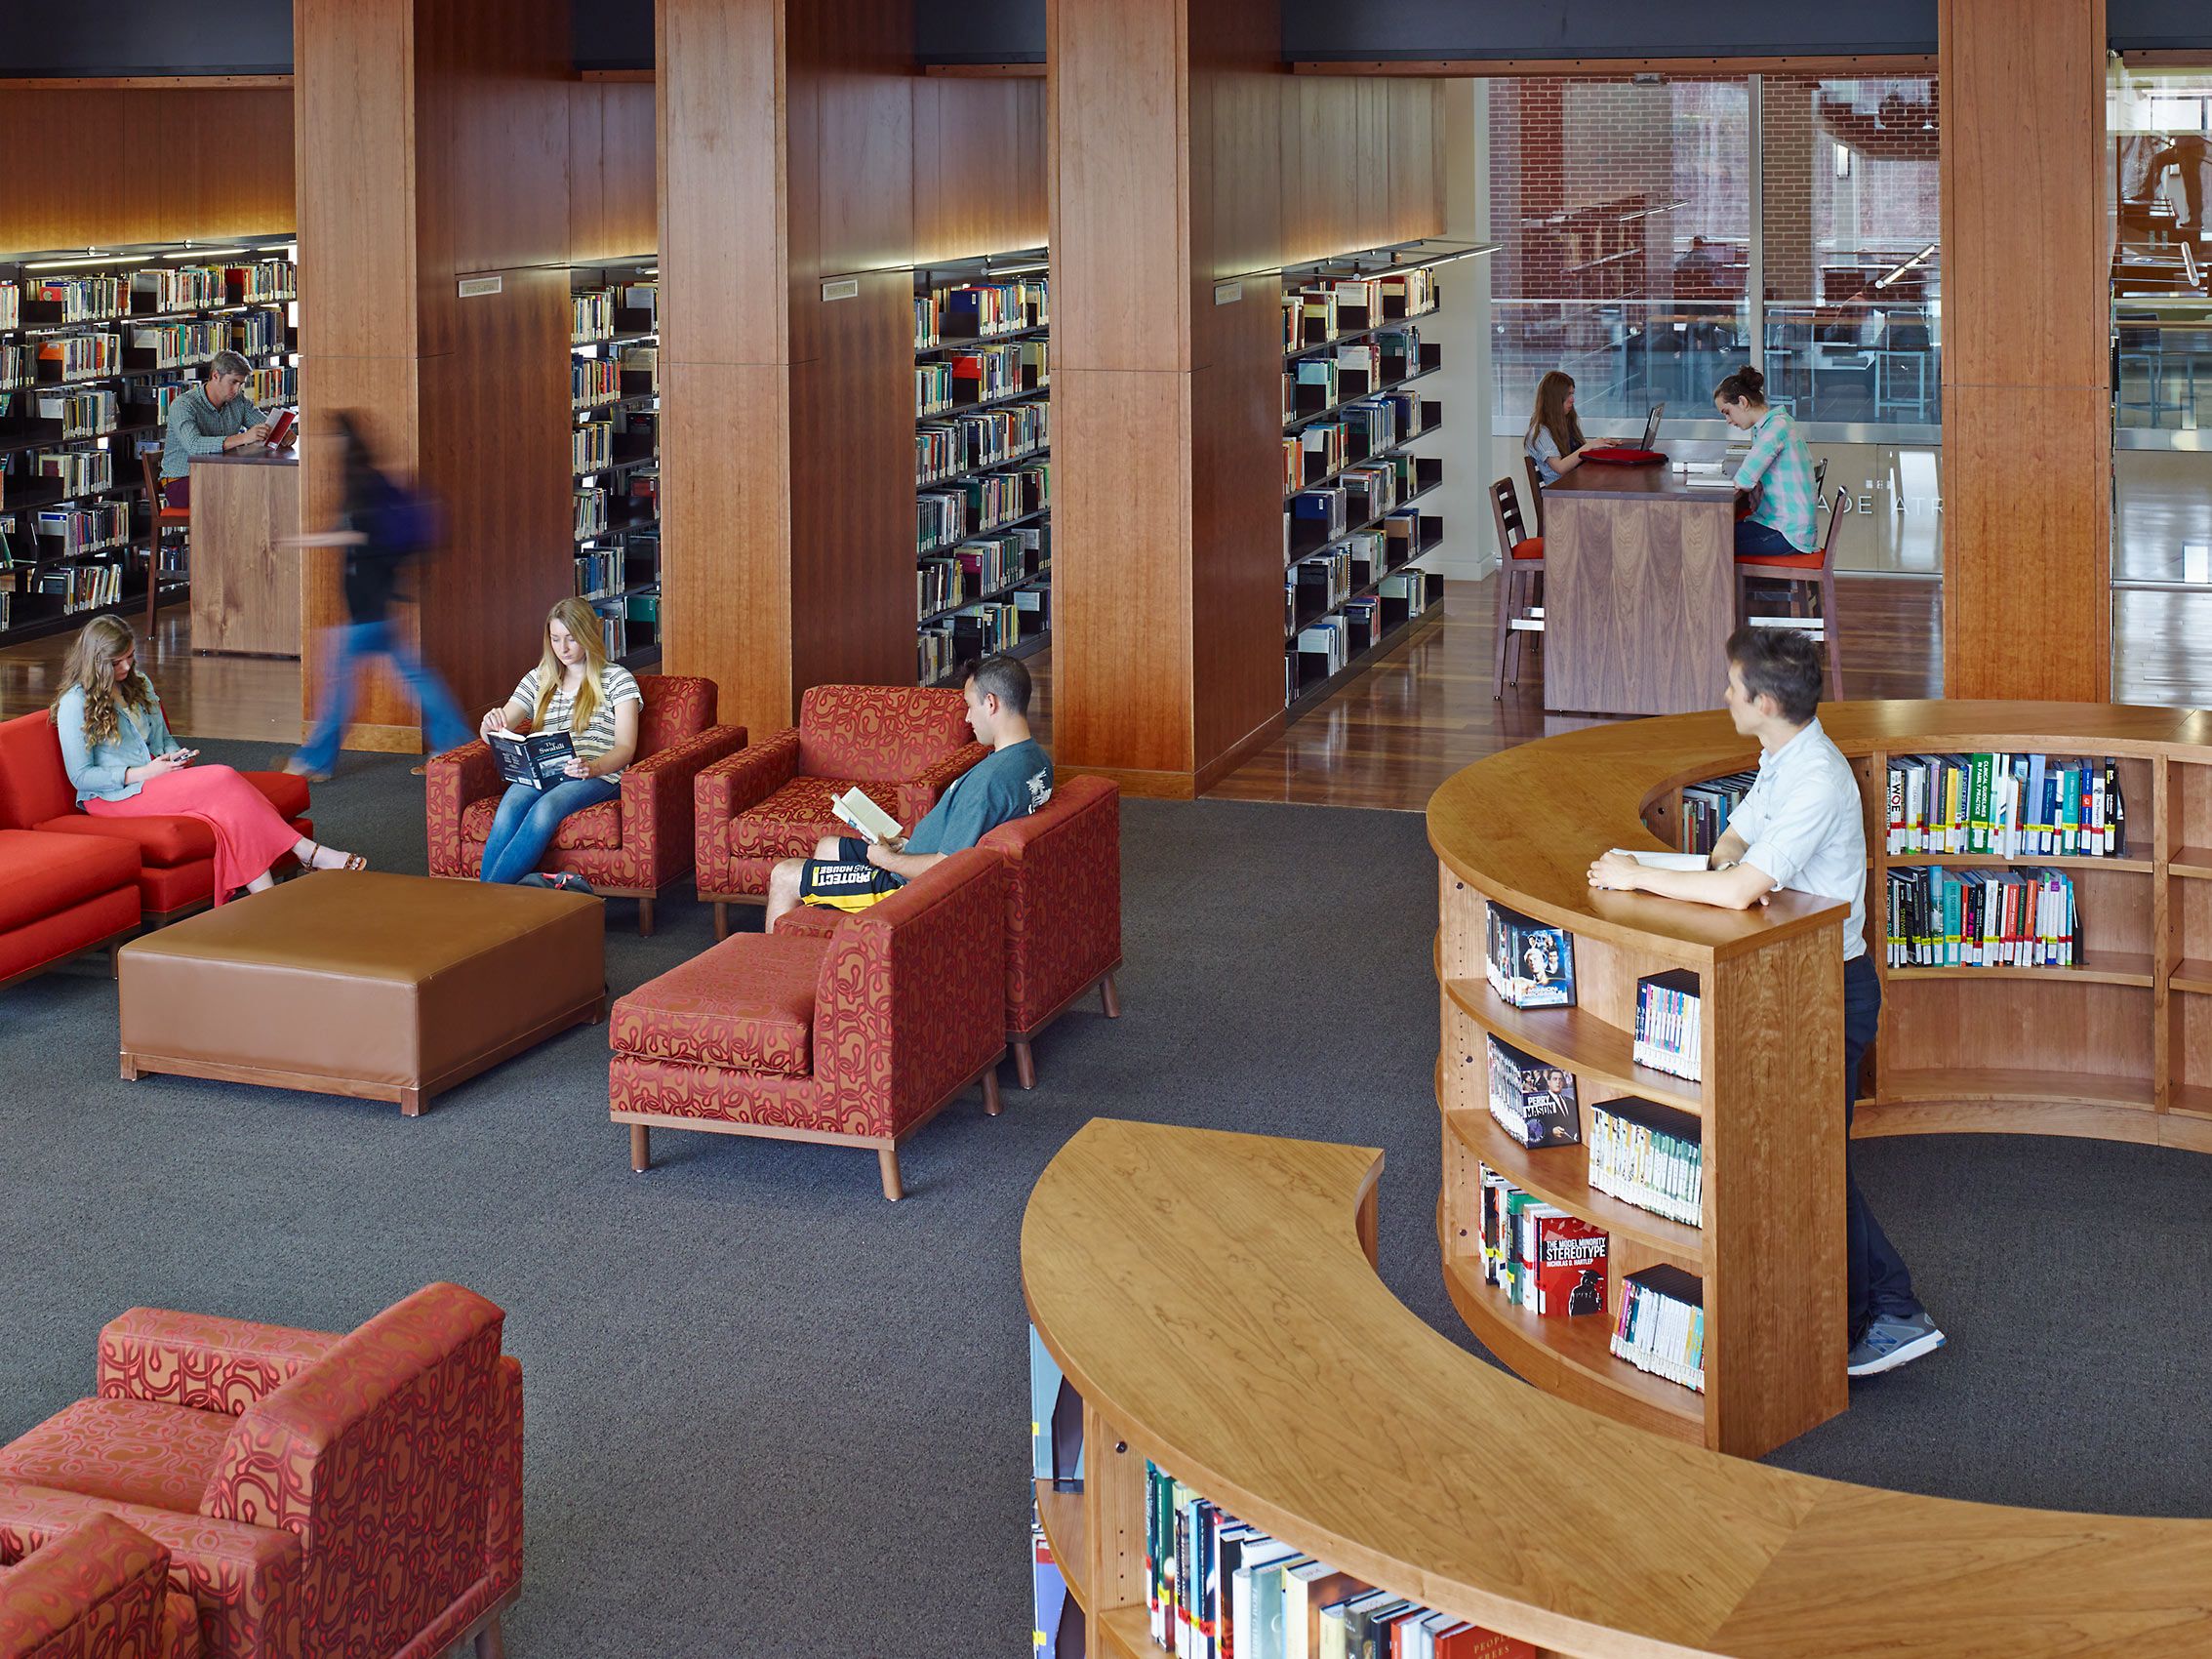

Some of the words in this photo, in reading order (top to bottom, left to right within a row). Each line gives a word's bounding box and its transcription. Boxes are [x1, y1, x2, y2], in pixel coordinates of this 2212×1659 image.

[1891, 784, 1901, 812] WOE
[820, 866, 854, 874] HOUSE
[819, 871, 871, 886] PROTECT
[1527, 1095, 1550, 1106] PERRY
[1525, 1103, 1555, 1116] MASON
[1547, 1240, 1558, 1249] THE
[1558, 1238, 1578, 1248] MODEL
[1579, 1237, 1606, 1247] MINORITY
[1546, 1245, 1606, 1261] STEREOTYPE
